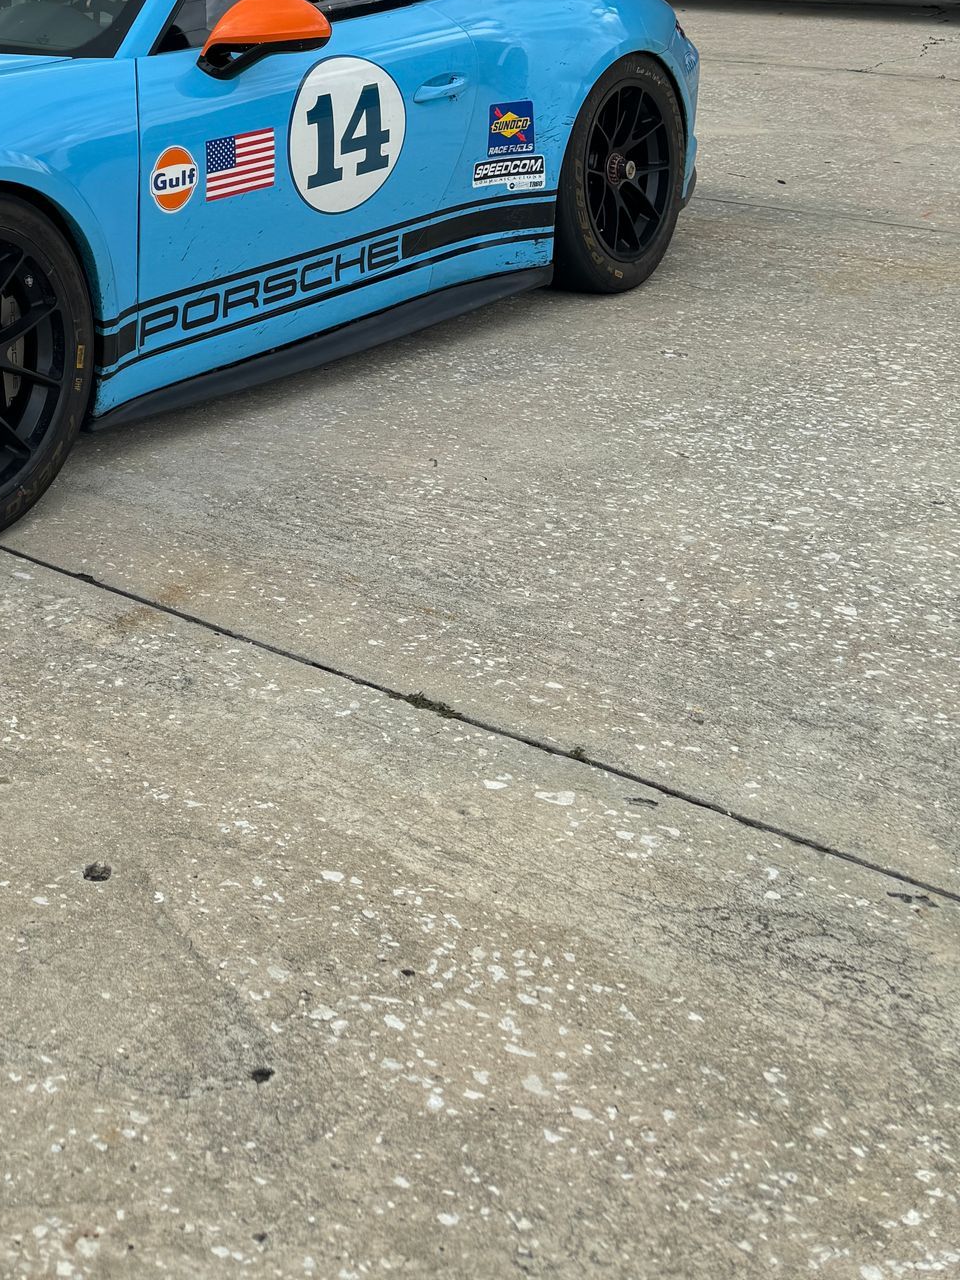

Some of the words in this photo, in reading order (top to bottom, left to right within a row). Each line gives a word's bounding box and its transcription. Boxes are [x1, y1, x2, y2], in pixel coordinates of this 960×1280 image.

[306, 83, 390, 189] 14
[492, 118, 529, 132] SUNOCO
[488, 145, 508, 155] RACE
[508, 143, 533, 153] FUELS
[153, 168, 196, 191] Gulf
[140, 235, 399, 346] PORSCHE
